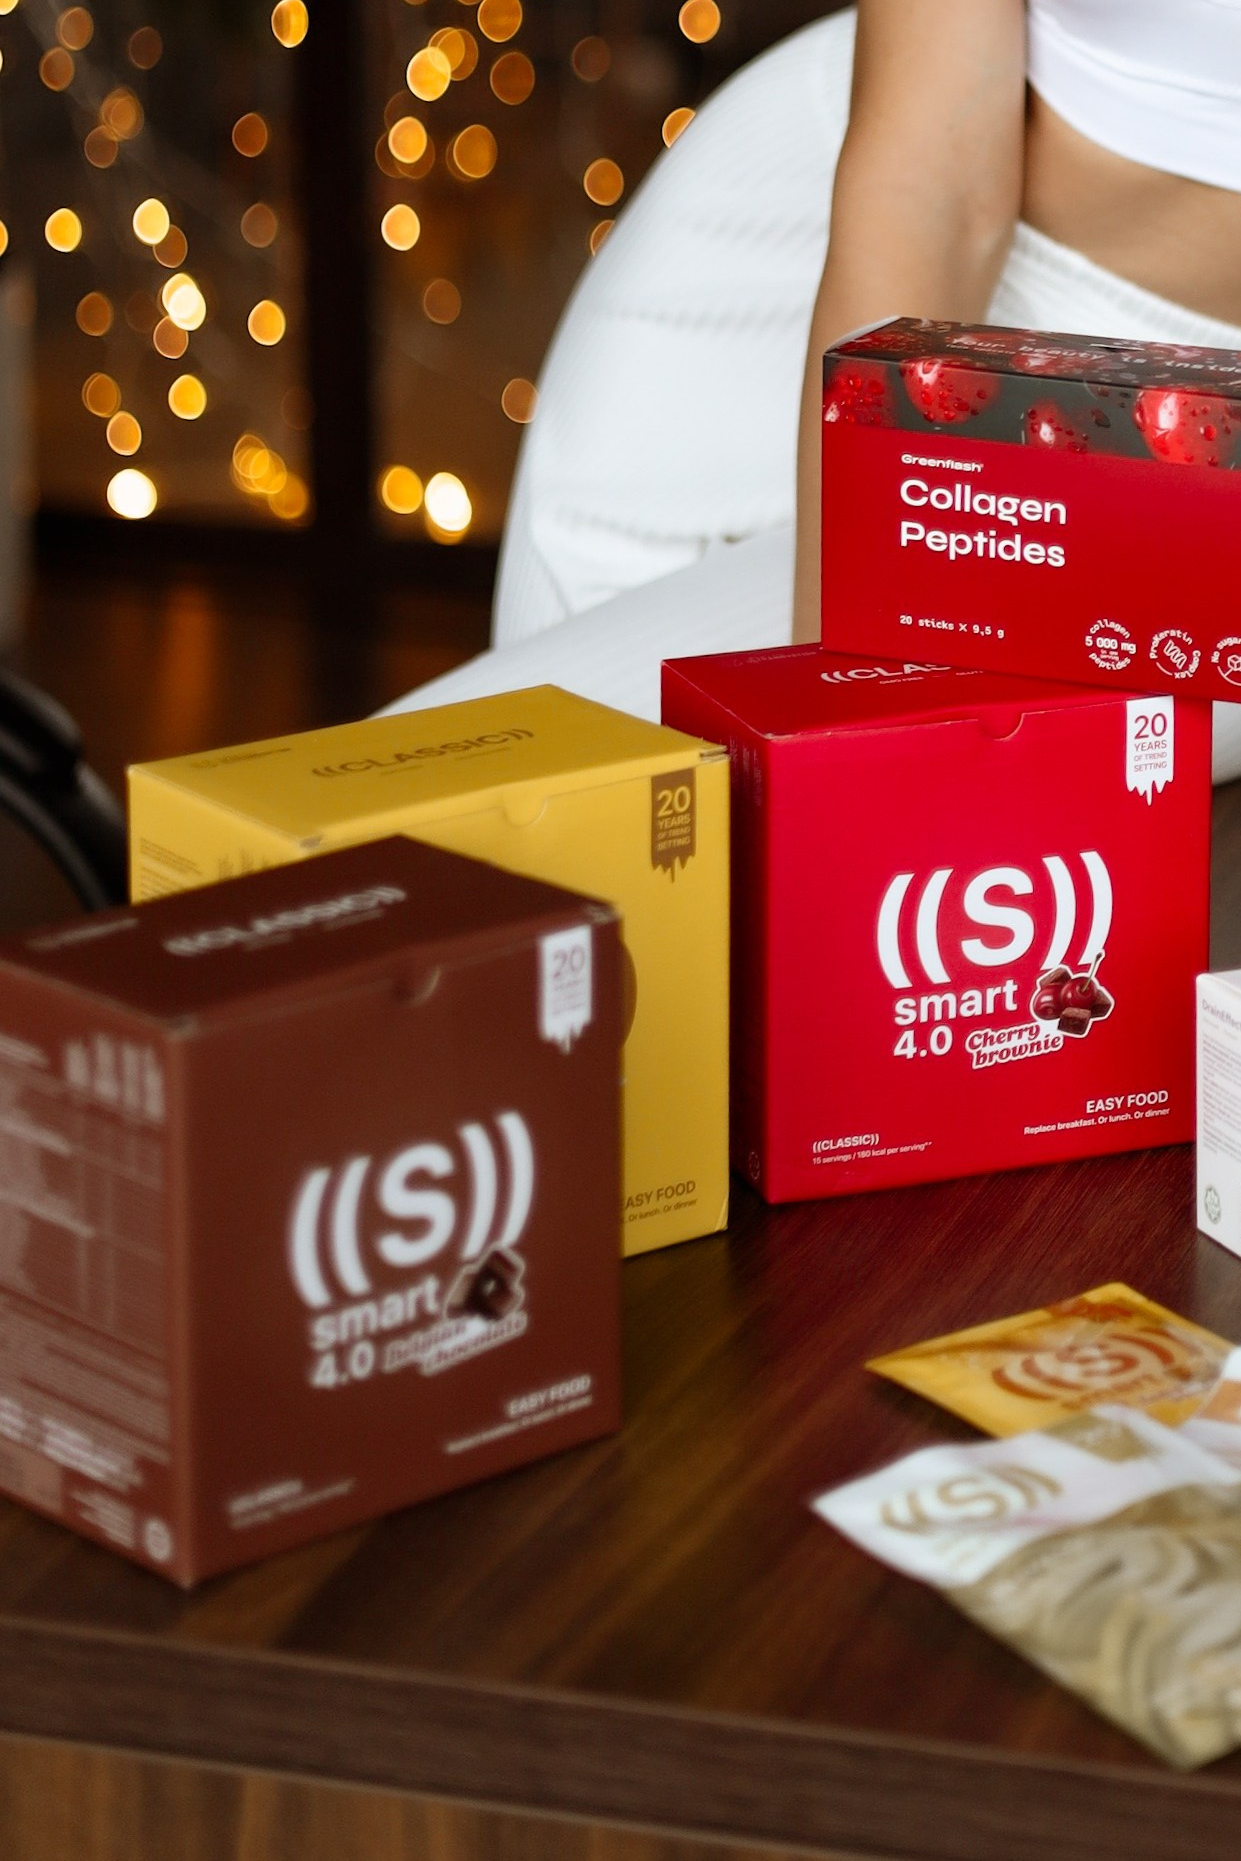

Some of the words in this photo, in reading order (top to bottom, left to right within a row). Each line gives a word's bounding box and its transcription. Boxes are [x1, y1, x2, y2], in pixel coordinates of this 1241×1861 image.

[1019, 344, 1105, 361] beauty
[900, 479, 1067, 527] Collagen
[900, 521, 1066, 568] Peptides
[899, 614, 913, 625] 20
[918, 618, 954, 631] sticks
[972, 624, 992, 637] 9,5
[996, 629, 1005, 639] g
[1089, 618, 1131, 640] collagen
[1085, 635, 1093, 647] 5
[1096, 637, 1118, 650] 000
[1121, 641, 1137, 655] mg
[1211, 650, 1220, 664] No
[1088, 652, 1131, 671] peptides
[1134, 712, 1167, 740] 20
[1134, 740, 1168, 752] YEARS
[1134, 754, 1144, 762] OF
[1145, 751, 1168, 761] TREND
[1134, 761, 1168, 773] SETTING
[658, 786, 691, 817] 20
[659, 813, 691, 830] YEARS
[553, 944, 585, 979] 20
[894, 979, 1018, 1026] smart
[893, 1025, 953, 1059] 4.0
[968, 1024, 1041, 1051] Cherry
[974, 1034, 1063, 1067] brownie
[1086, 1095, 1124, 1114] EASY
[1126, 1090, 1169, 1108] FOOD
[1023, 1123, 1057, 1135] Replace
[1057, 1118, 1097, 1131] breakfast.
[1097, 1115, 1108, 1125] Or
[1108, 1112, 1133, 1123] lunch.
[1134, 1111, 1144, 1119] Or
[1144, 1107, 1170, 1118] dinner
[812, 1133, 880, 1154] ((CLASSIC))
[812, 1156, 821, 1165] 15
[822, 1153, 852, 1165] servings
[872, 1147, 886, 1157] kcal
[886, 1146, 899, 1156] per
[625, 1190, 653, 1211] ASY
[656, 1180, 696, 1201] FOOD
[311, 1274, 441, 1352] smart
[310, 1339, 376, 1390] 4.0
